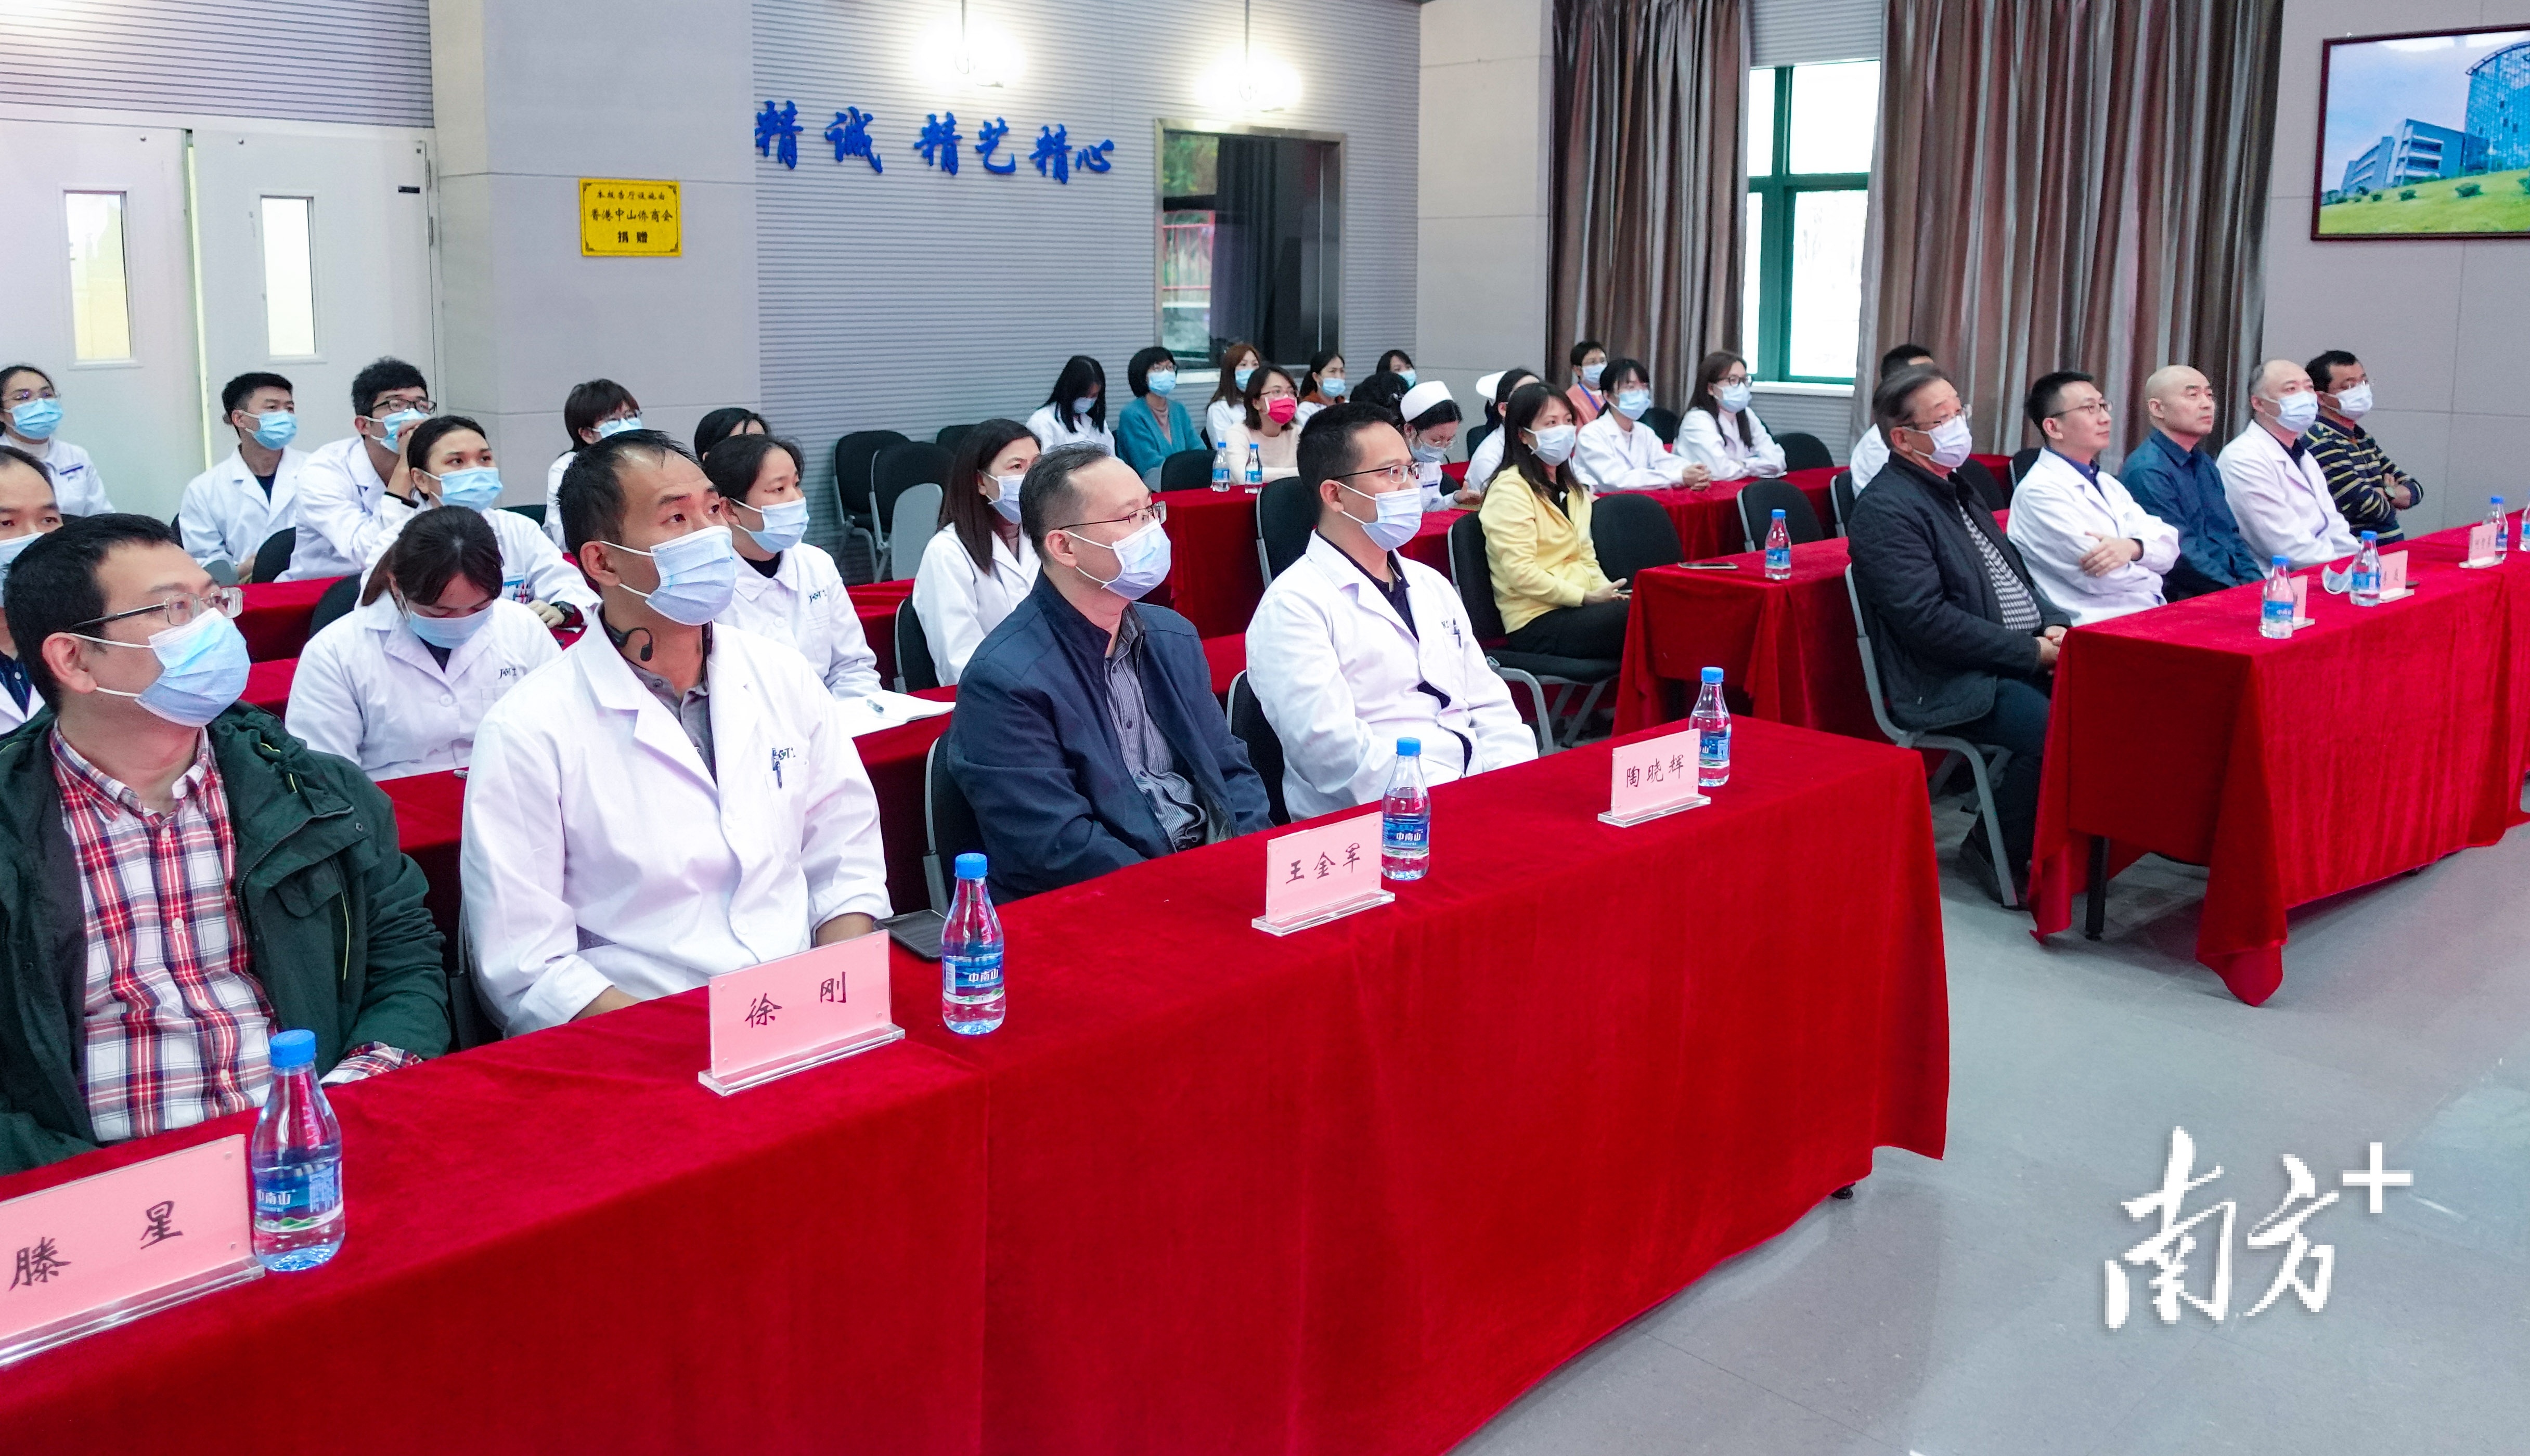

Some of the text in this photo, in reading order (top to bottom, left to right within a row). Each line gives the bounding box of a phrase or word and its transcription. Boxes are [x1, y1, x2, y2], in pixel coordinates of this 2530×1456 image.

[591, 207, 673, 222] 香港中山侨商会
[617, 231, 648, 243] 捐赠
[1626, 754, 1684, 788] 陶晓辉
[1396, 832, 1421, 841] 中南山
[1286, 842, 1361, 885] 王金军
[968, 968, 999, 983] 中南山
[744, 971, 847, 1029] 徐刚
[9, 1201, 183, 1292] 滕星
